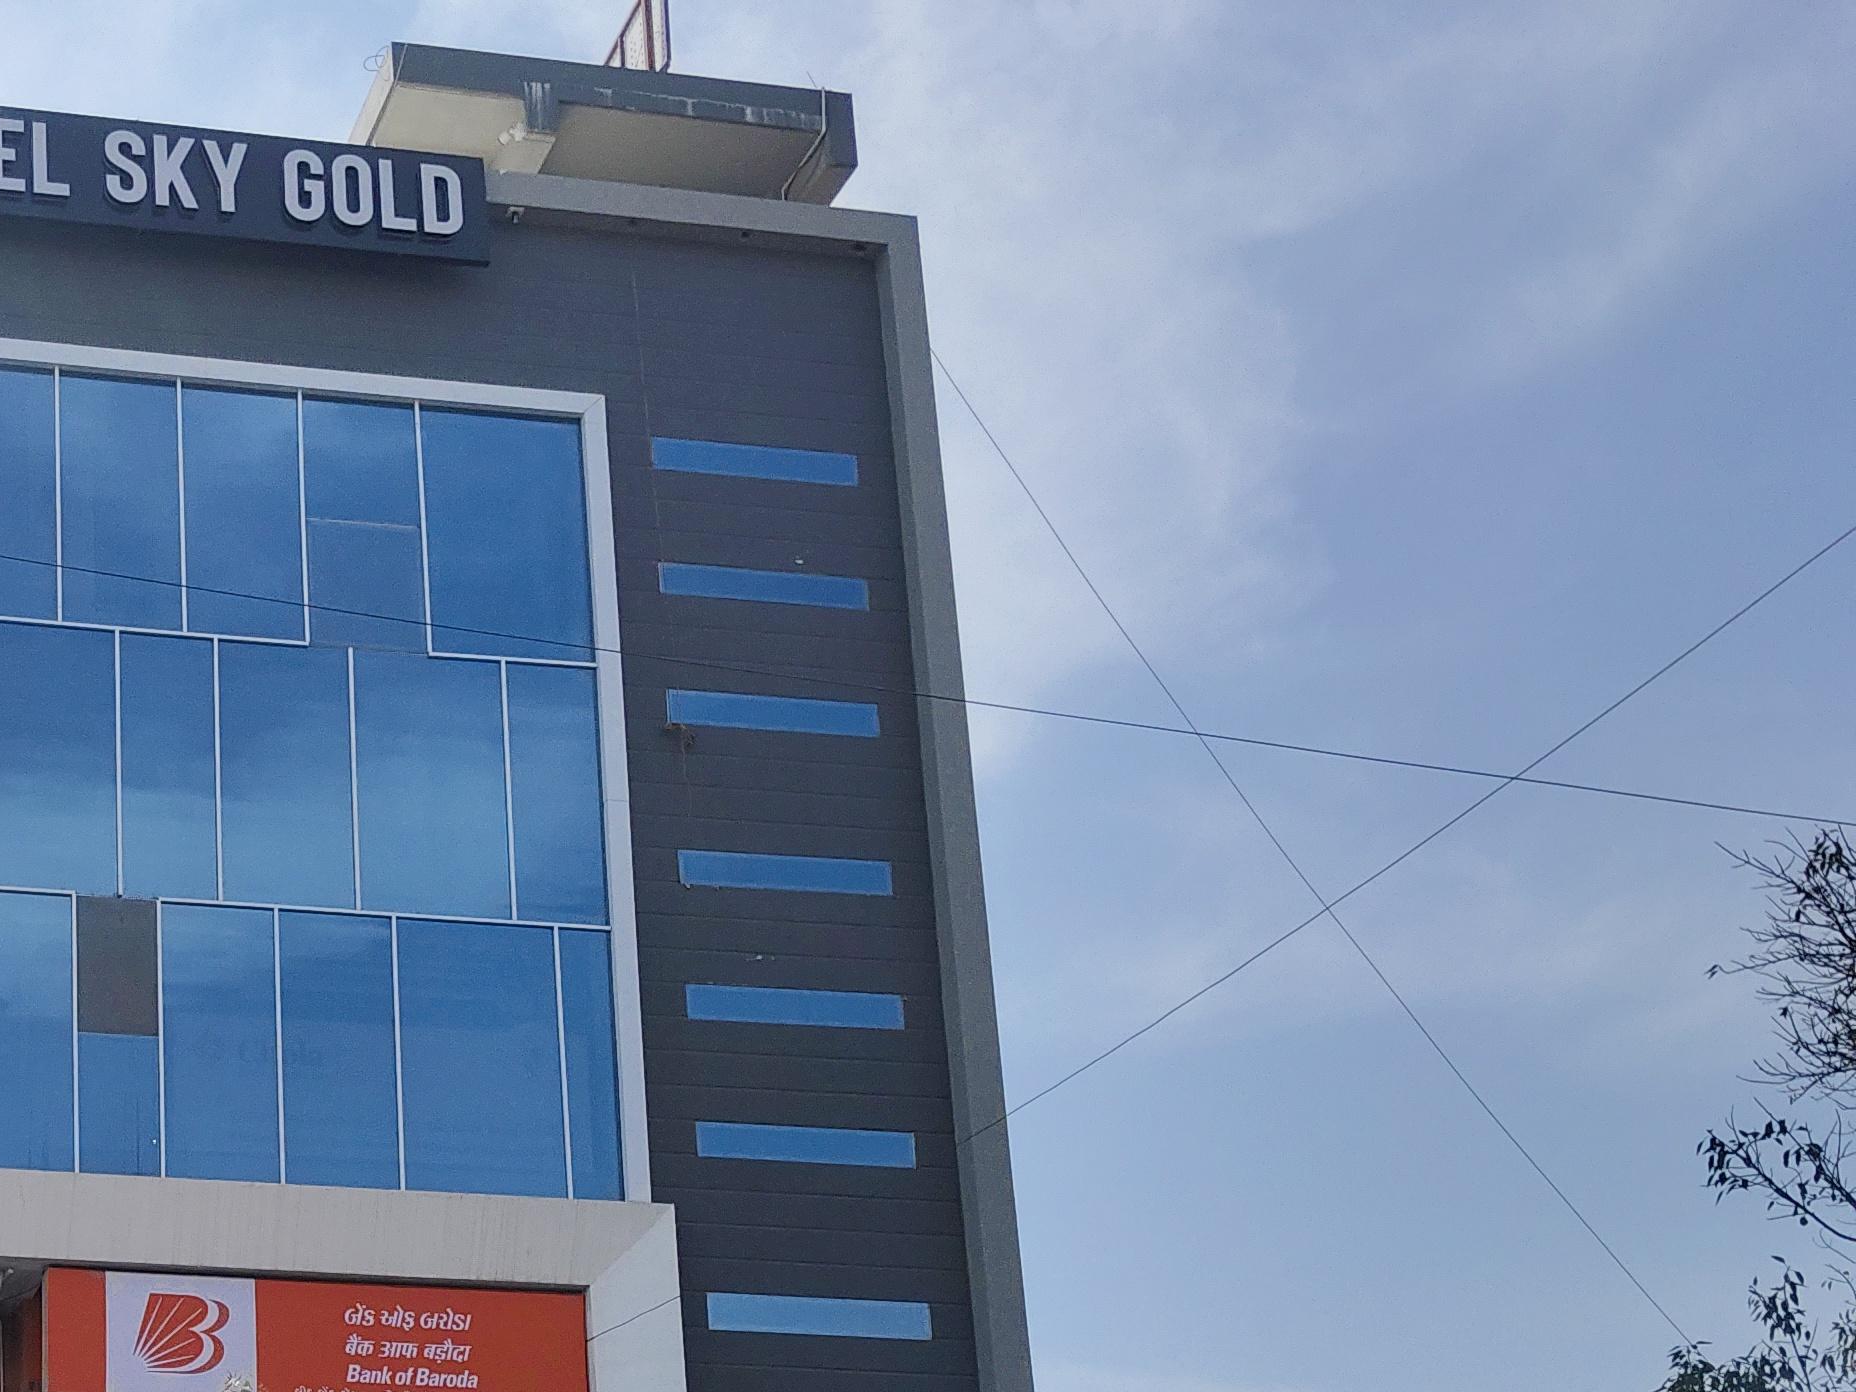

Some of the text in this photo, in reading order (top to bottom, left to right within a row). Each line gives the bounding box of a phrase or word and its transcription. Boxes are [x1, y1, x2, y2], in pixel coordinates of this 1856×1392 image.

[104, 129, 249, 213] SKY
[283, 147, 466, 236] GOLD
[344, 1302, 376, 1327] બેંક
[420, 1307, 472, 1331] બરોડા
[345, 1333, 376, 1357] बैंक
[423, 1338, 473, 1364] बड़ौदा
[346, 1364, 478, 1389] Bank of Baroda
